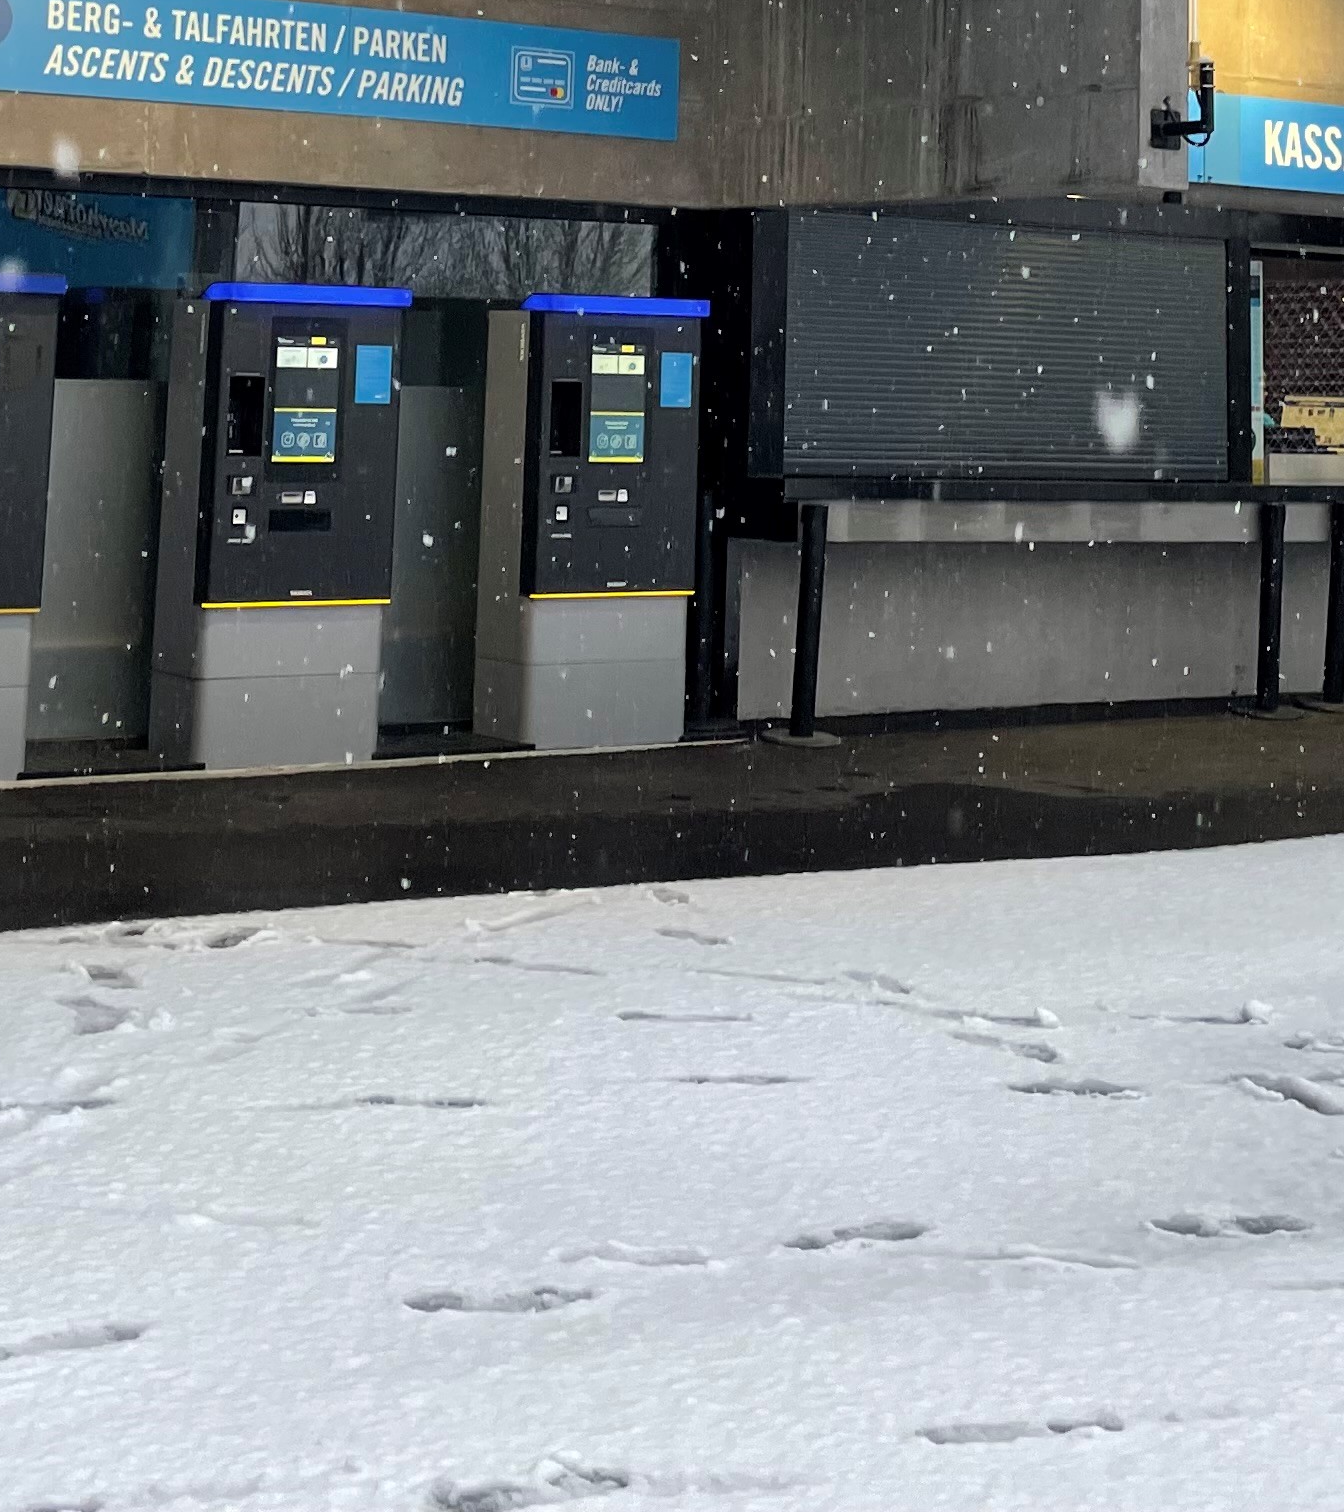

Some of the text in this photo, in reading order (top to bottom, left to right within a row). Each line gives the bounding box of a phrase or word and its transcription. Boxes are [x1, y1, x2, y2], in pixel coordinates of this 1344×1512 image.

[143, 6, 162, 39] &
[171, 9, 327, 53] TALFAHRTEN
[353, 26, 448, 64] PARKEN
[43, 44, 170, 84] ASCENTS
[174, 54, 195, 86] &
[202, 56, 335, 97] DESCENTS
[357, 69, 465, 108] PARKING
[587, 54, 639, 77] Bank- &
[586, 74, 662, 97] Creditcards
[586, 94, 624, 113] ONLY!
